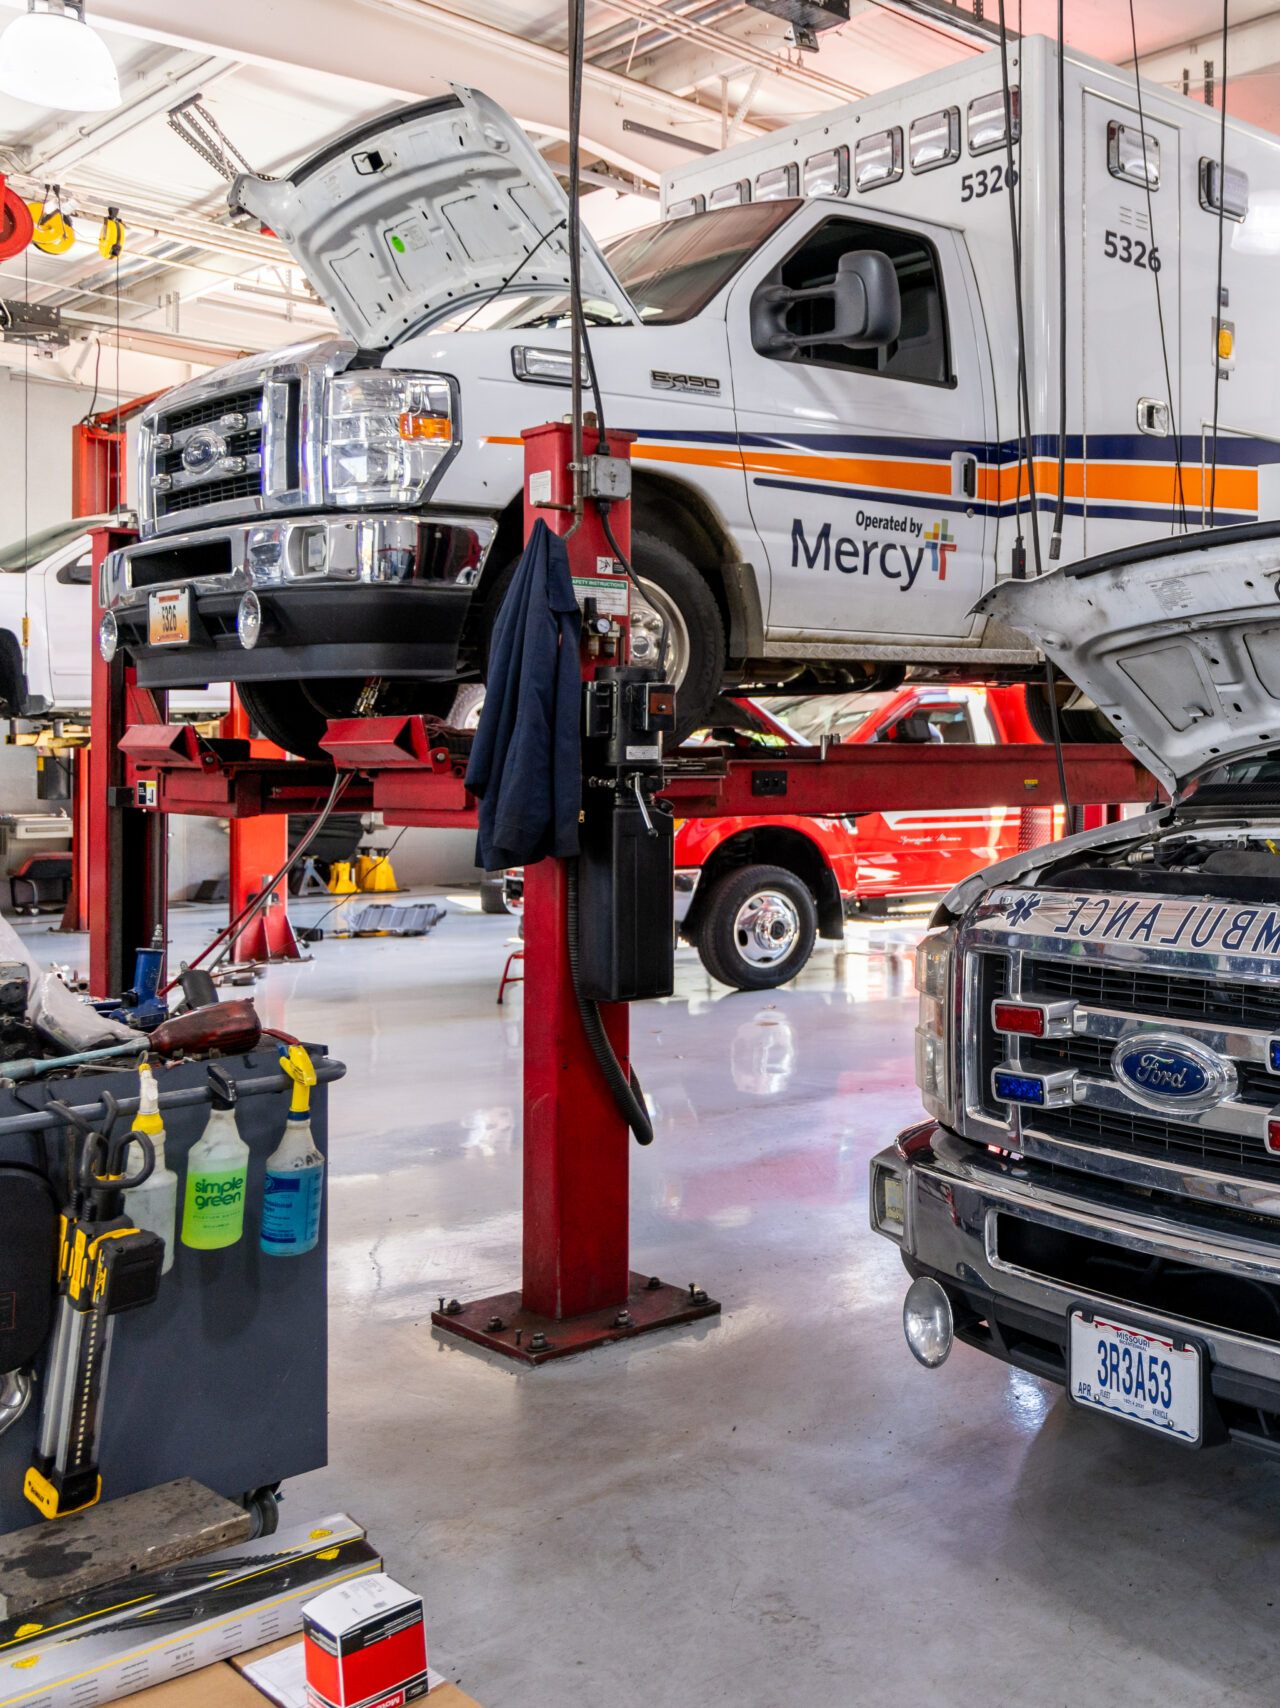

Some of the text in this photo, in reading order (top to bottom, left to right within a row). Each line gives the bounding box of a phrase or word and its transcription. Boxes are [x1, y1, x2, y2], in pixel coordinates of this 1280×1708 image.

[1104, 229, 1162, 273] 5326
[855, 510, 923, 538] Operated by
[791, 518, 925, 592] Mercy
[1135, 1053, 1187, 1089] Ford
[195, 1176, 244, 1197] simple
[194, 1191, 242, 1210] green
[1116, 1330, 1150, 1349] MISSOURI
[1097, 1339, 1172, 1410] 3R3A53
[1077, 1381, 1092, 1398] APR
[1100, 1389, 1111, 1400] FLEET
[1151, 1407, 1169, 1420] VEHICLE
